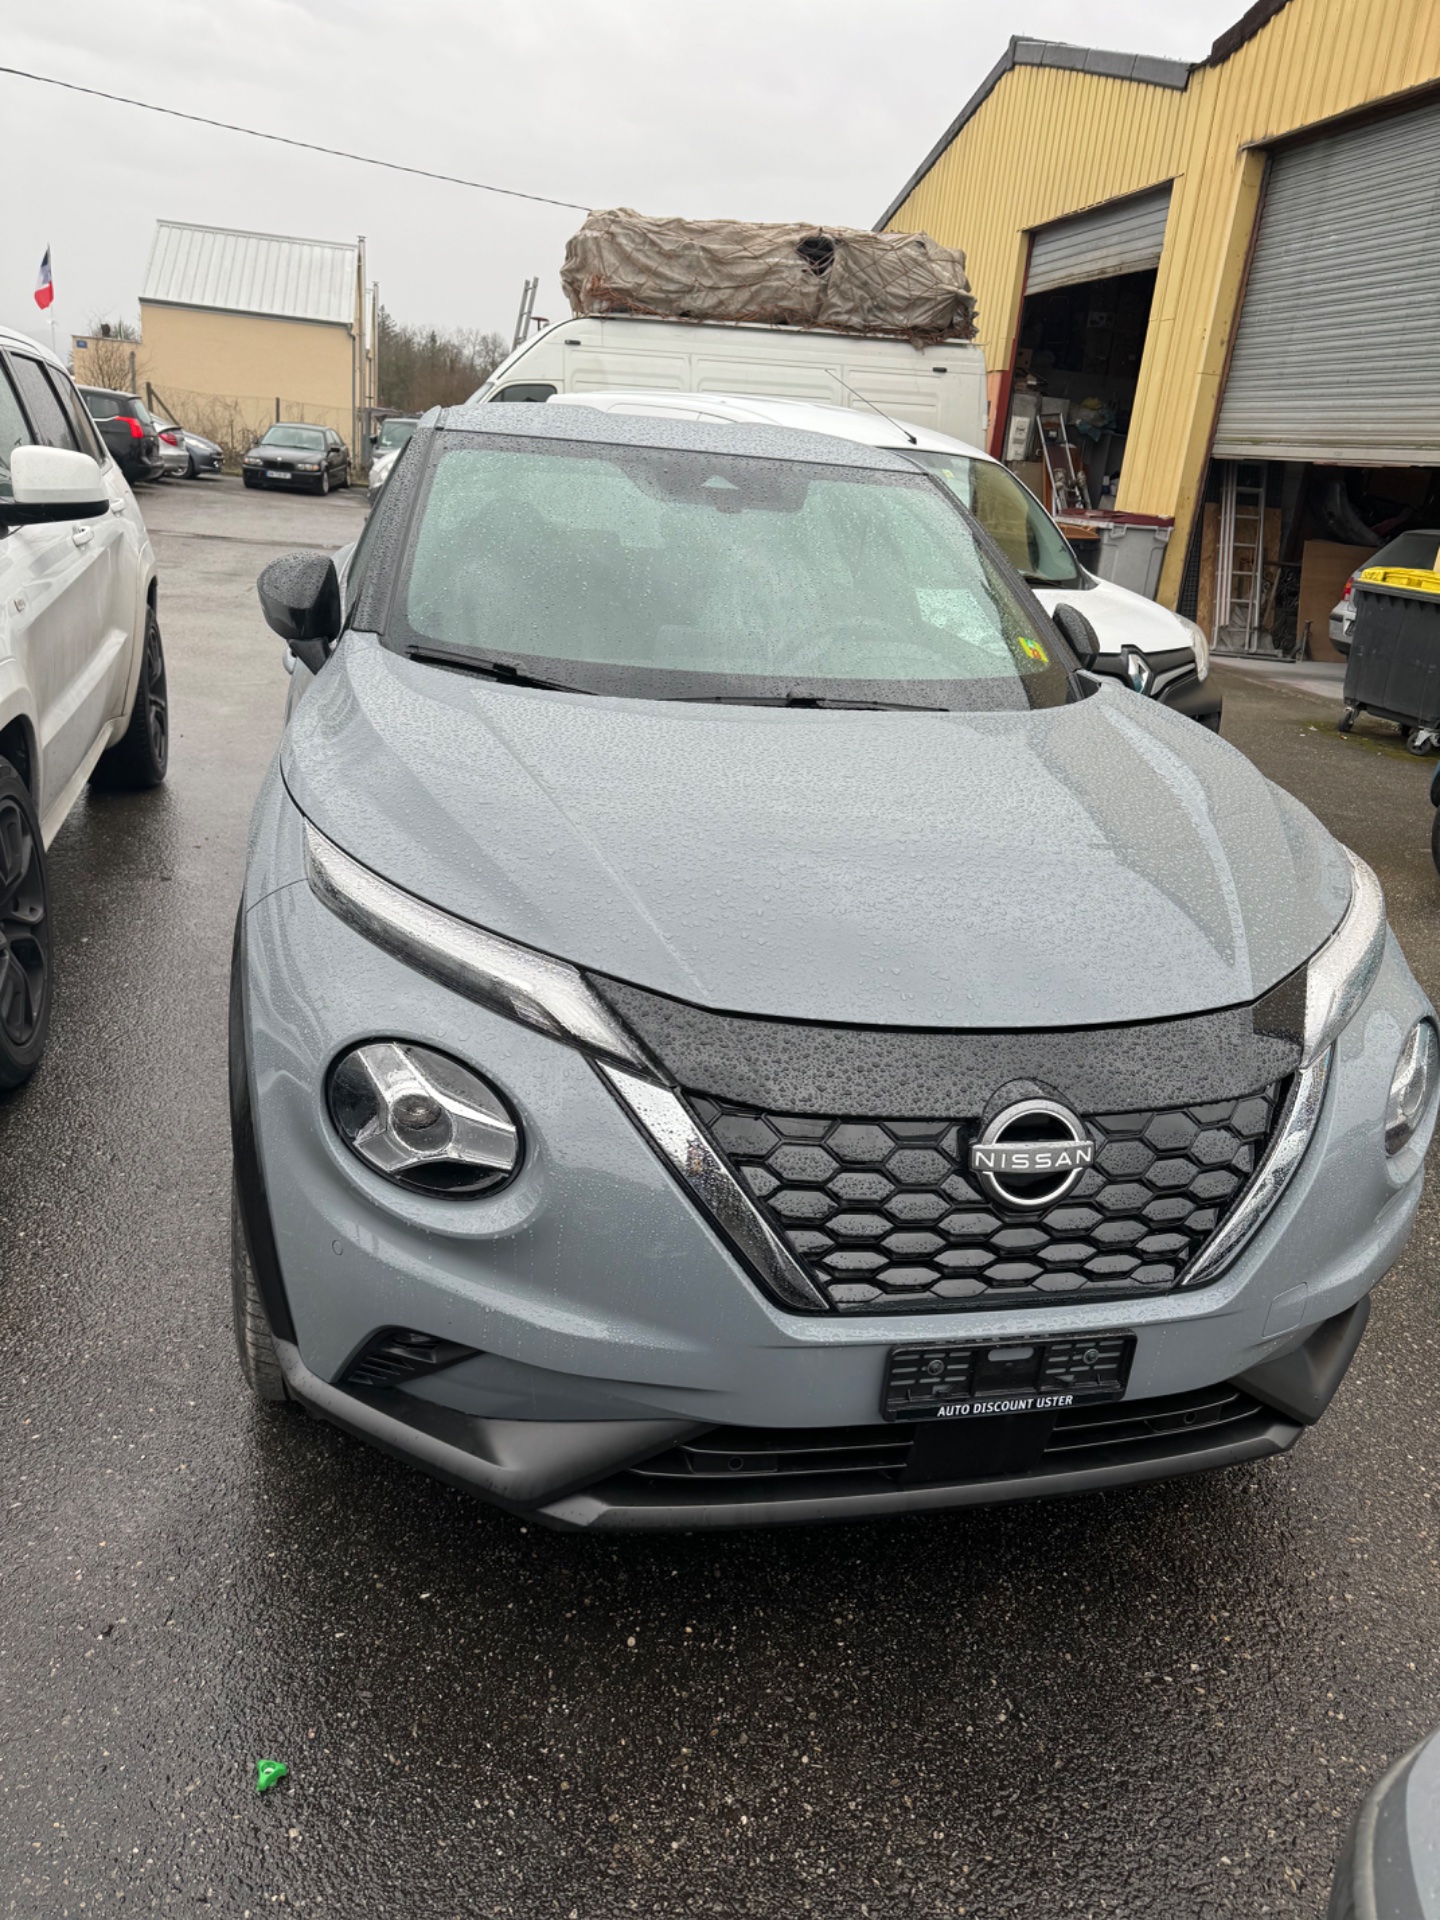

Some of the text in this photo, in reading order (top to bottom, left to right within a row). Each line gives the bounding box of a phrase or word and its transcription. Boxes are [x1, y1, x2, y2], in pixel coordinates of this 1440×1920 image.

[975, 1147, 1092, 1169] NISSAN
[937, 1395, 1074, 1417] AUTO DISCOUNT USTER
